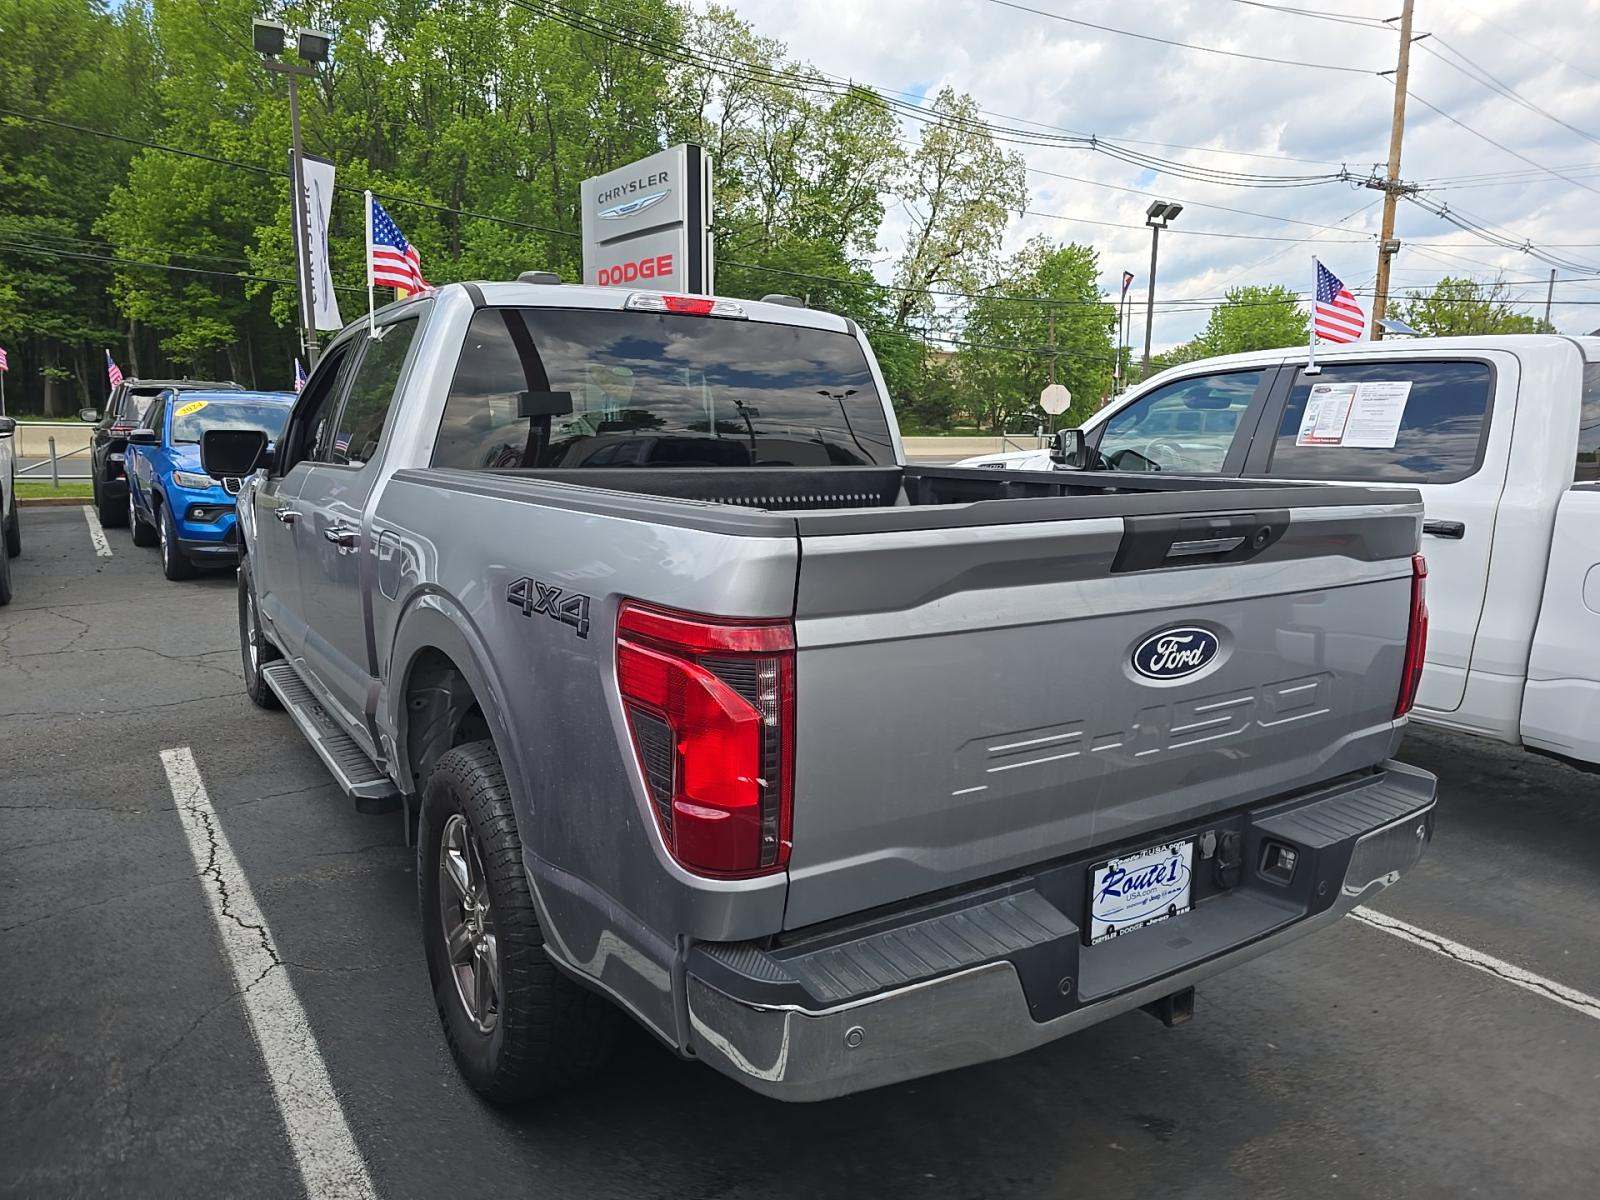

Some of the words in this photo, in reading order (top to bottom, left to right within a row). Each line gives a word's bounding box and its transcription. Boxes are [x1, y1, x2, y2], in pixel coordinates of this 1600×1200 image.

[597, 170, 670, 205] CHRYSLER
[597, 254, 674, 287] DODGE
[506, 576, 591, 639] 4X4
[1149, 634, 1206, 672] Ford
[1126, 886, 1158, 901] USA.com
[1119, 921, 1144, 937] DODGE
